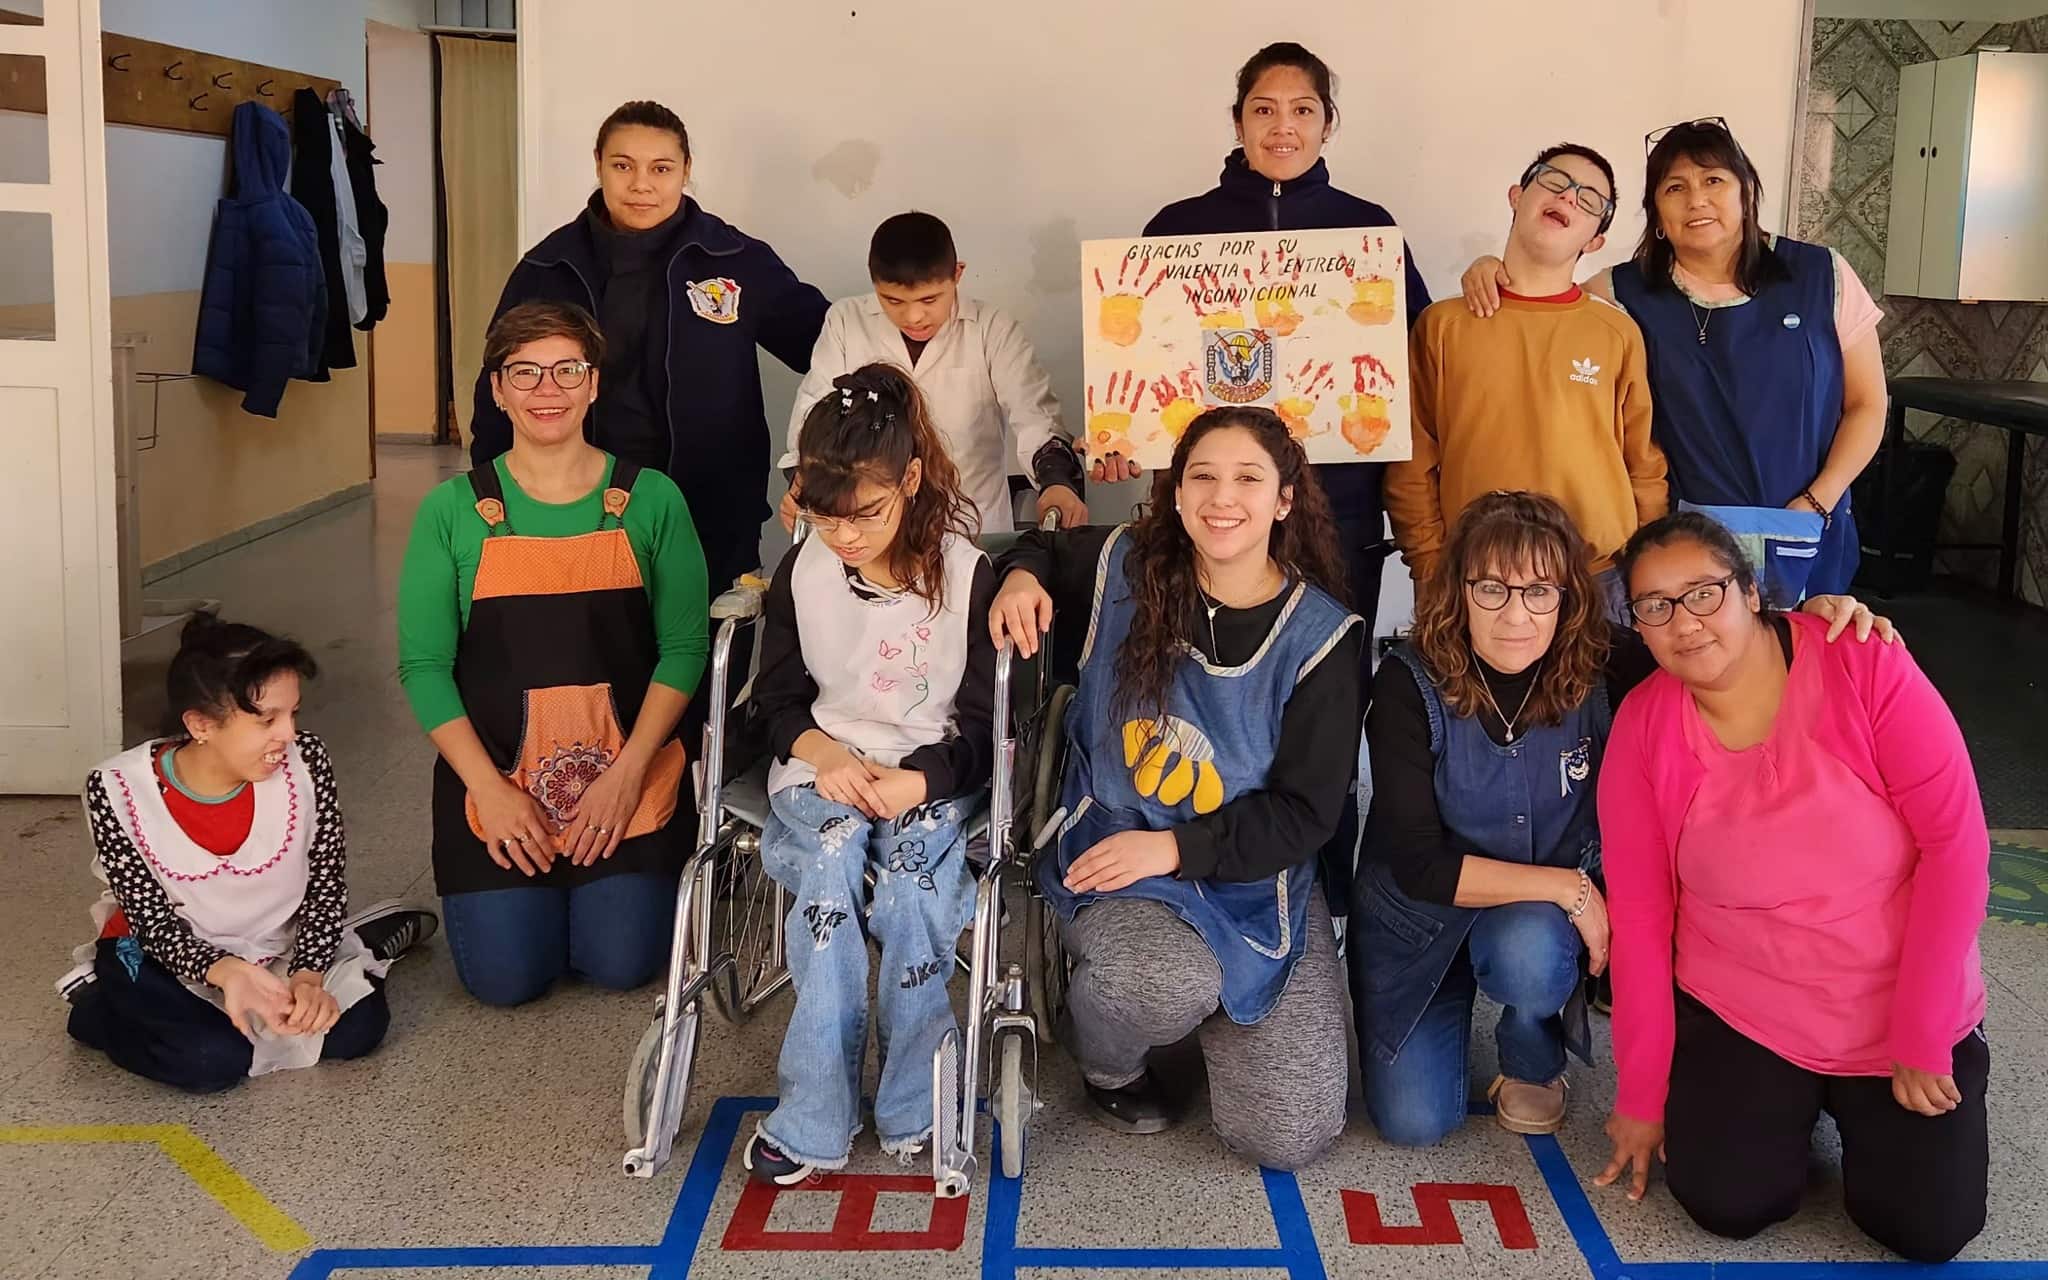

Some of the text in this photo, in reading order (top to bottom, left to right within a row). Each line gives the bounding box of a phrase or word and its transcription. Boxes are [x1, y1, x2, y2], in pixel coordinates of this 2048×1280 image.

[1127, 239, 1299, 260] GRACIAS POR SU
[1165, 256, 1357, 280] VALENTIA Y ENTREGA
[1185, 283, 1318, 305] INCONDICIONAL
